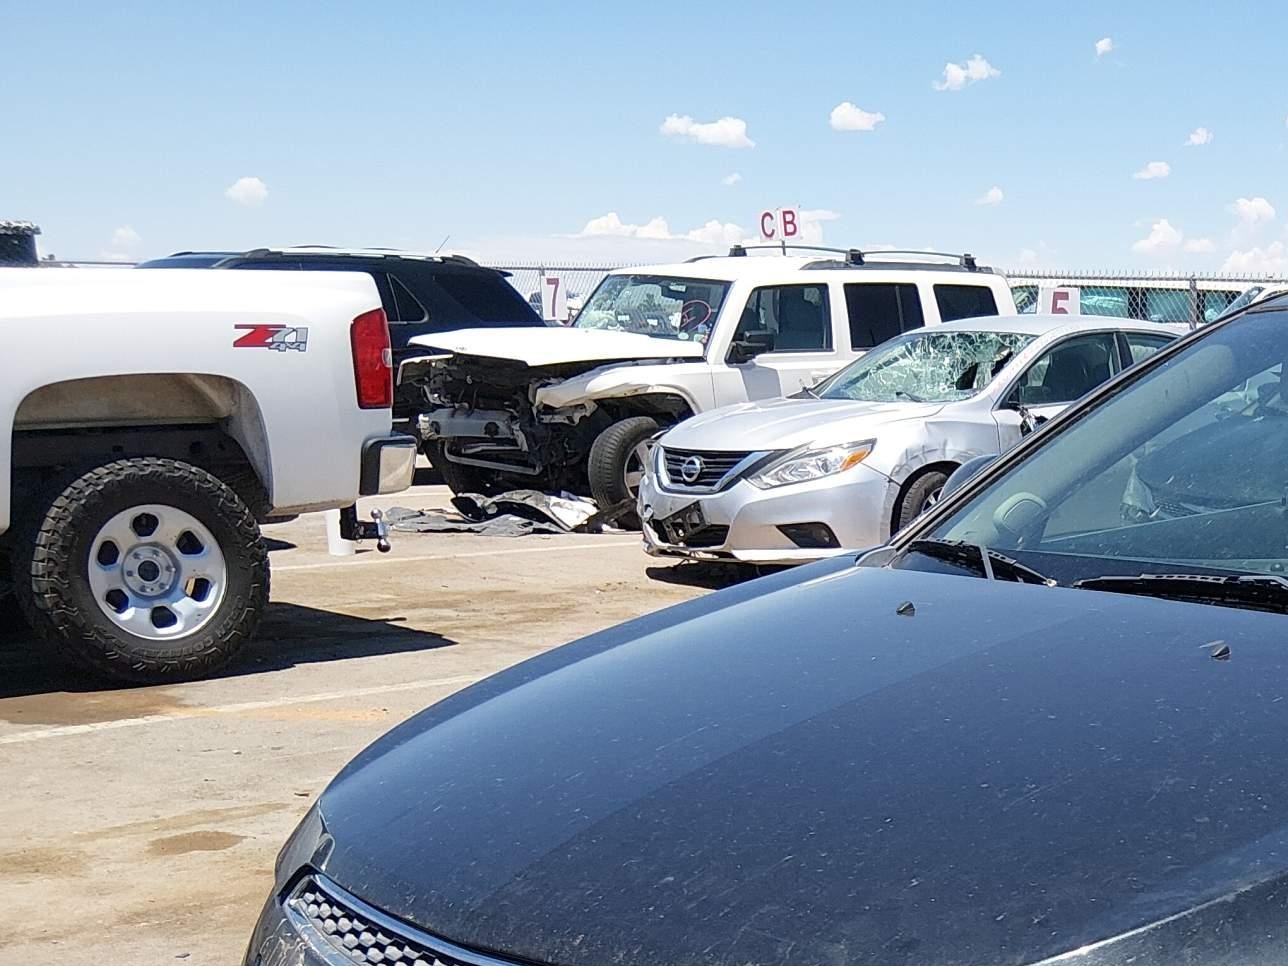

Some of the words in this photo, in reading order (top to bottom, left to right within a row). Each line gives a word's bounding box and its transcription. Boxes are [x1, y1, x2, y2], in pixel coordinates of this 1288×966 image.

[761, 212, 775, 238] C
[782, 210, 797, 237] B
[546, 278, 560, 317] 7
[233, 324, 308, 347] Z71
